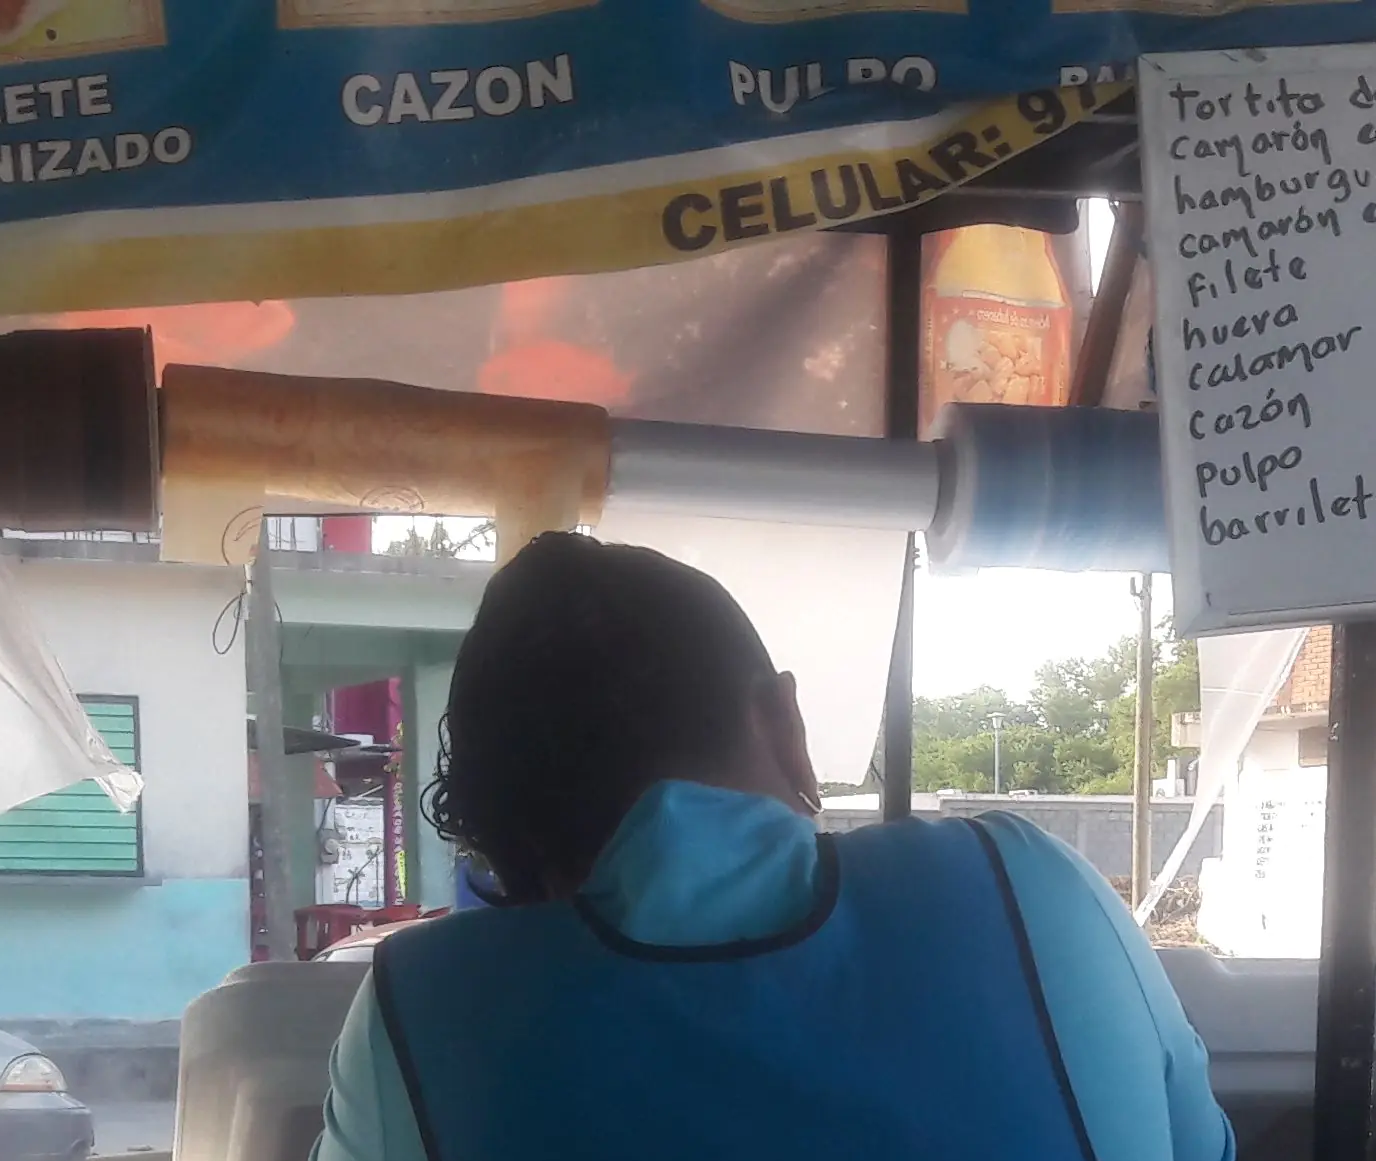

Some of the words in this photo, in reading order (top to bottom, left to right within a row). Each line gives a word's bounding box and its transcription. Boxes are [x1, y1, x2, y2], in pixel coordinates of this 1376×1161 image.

[341, 55, 573, 125] CAZON
[1170, 120, 1332, 177] camarón
[662, 125, 1013, 252] CELULAR:
[1179, 205, 1341, 258] camarón
[1183, 303, 1298, 350] hueva
[1189, 326, 1362, 391] calamar
[1189, 388, 1311, 440] cazón
[1196, 446, 1302, 498] pulpo
